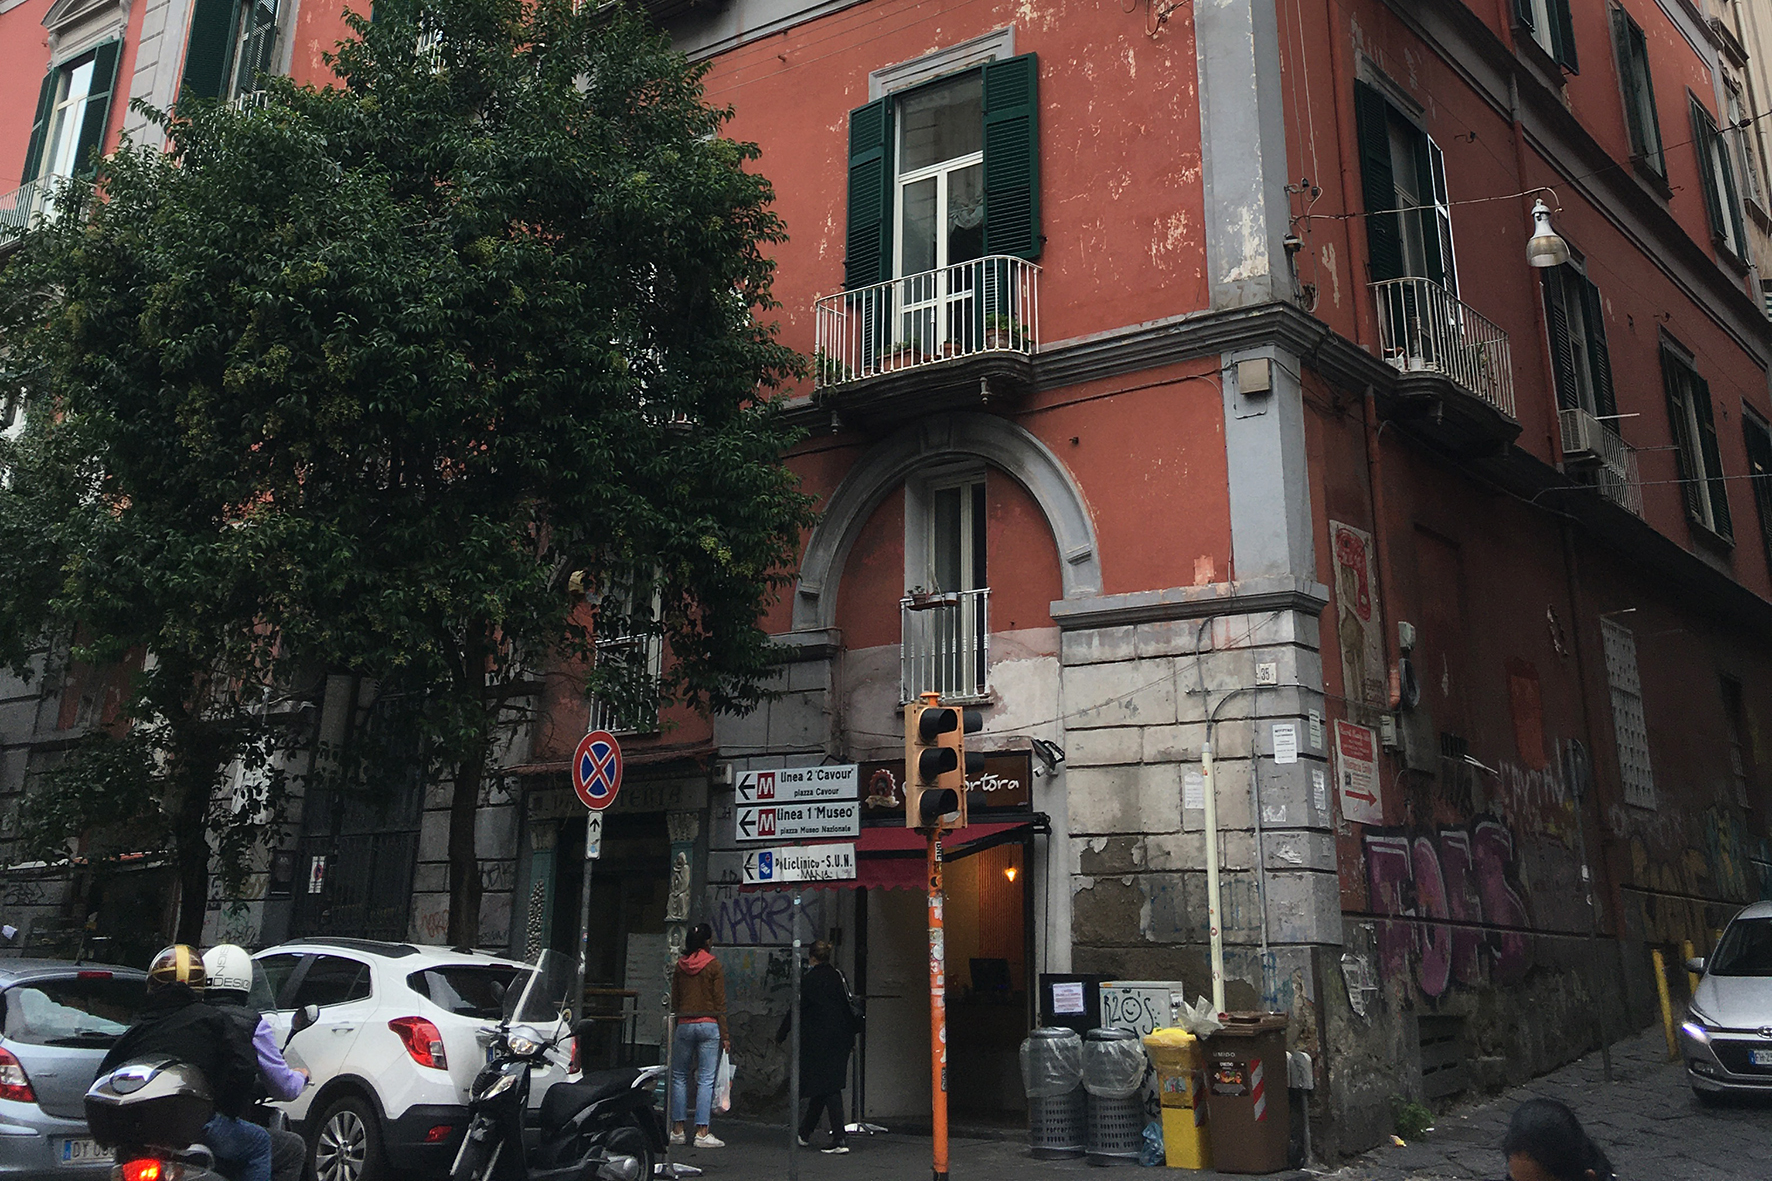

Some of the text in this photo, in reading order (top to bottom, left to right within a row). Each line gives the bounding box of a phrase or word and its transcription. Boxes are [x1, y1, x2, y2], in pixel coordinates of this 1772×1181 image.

[1260, 668, 1270, 681] 35
[757, 776, 774, 795] M
[780, 771, 804, 783] linea
[806, 770, 813, 781] 2
[962, 772, 1020, 792] ortora
[794, 787, 839, 798] piazza Cavour
[758, 813, 775, 832] M
[777, 808, 803, 821] linea
[807, 808, 812, 819] 1
[780, 825, 851, 835] piazza Museo Nazionale
